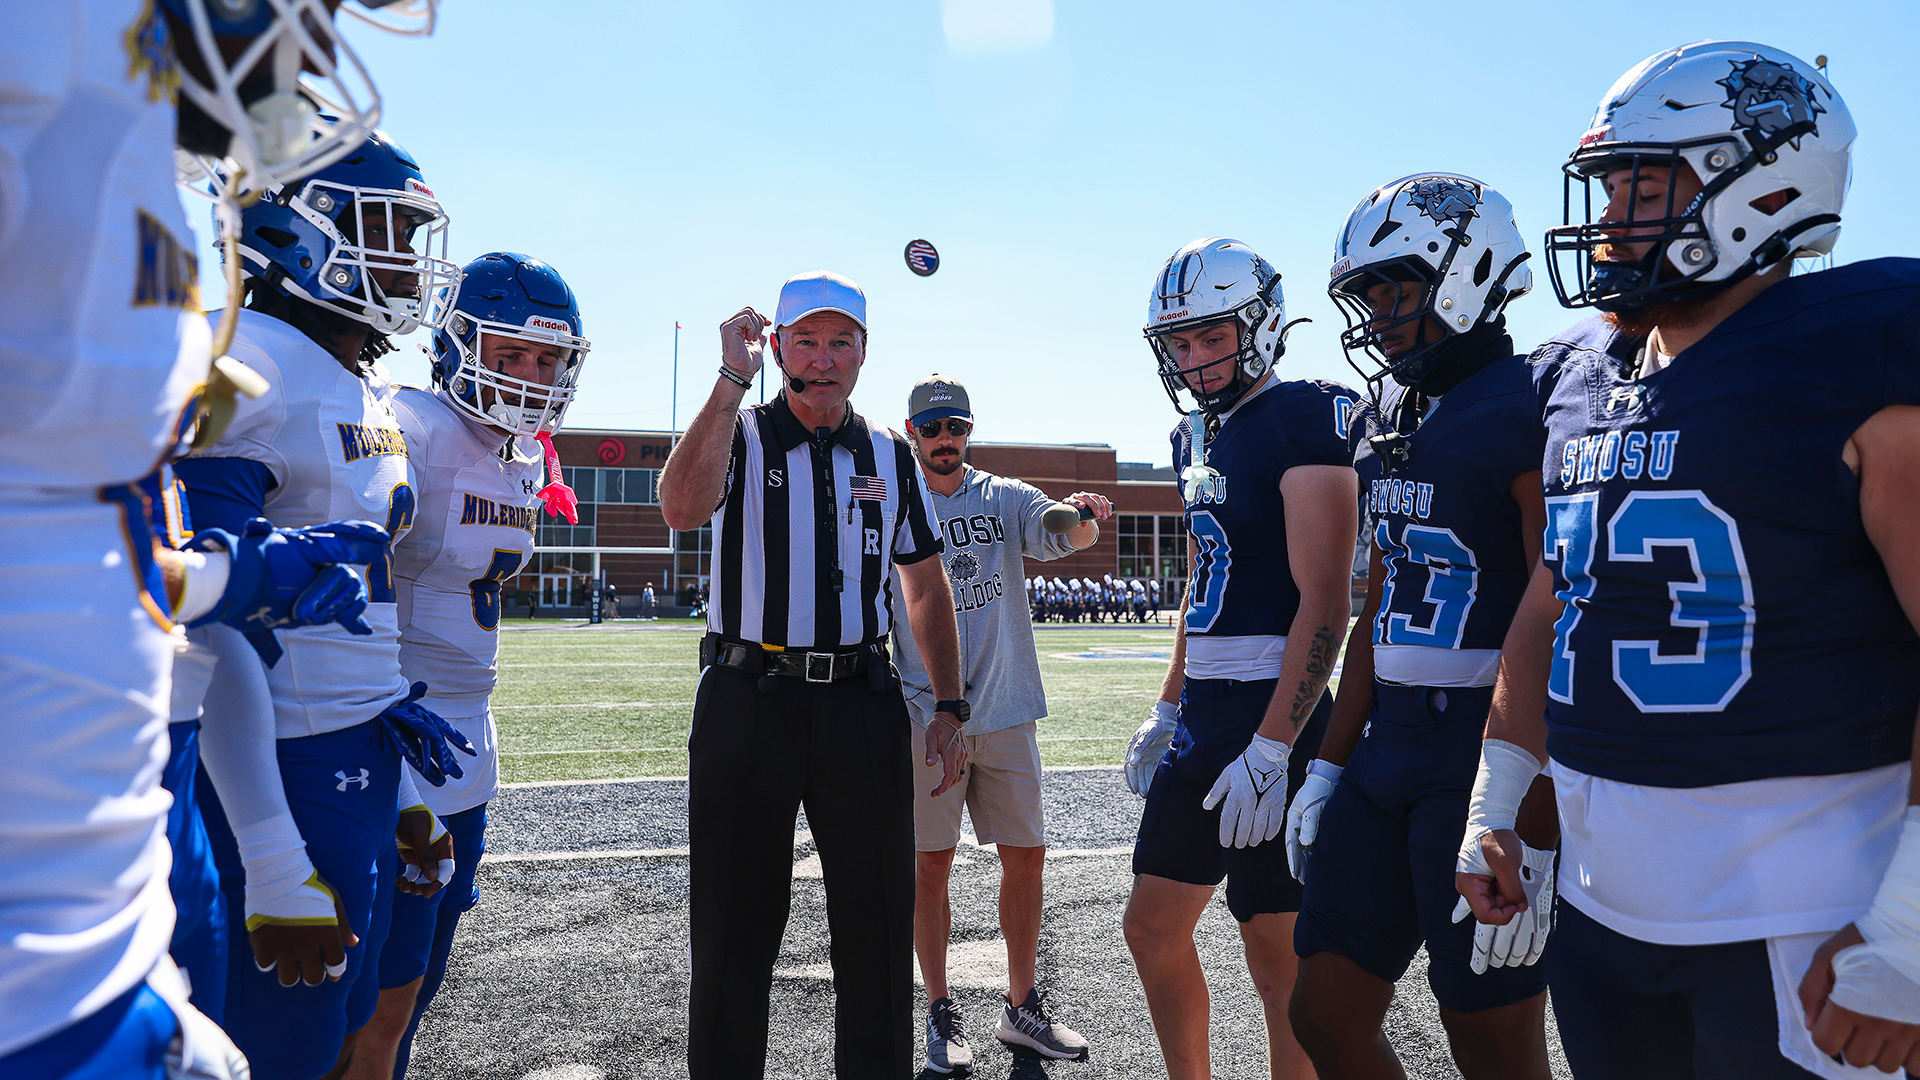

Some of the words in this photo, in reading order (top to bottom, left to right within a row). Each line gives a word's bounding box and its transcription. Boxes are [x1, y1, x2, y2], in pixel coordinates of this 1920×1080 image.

[1331, 260, 1351, 278] ddell
[533, 318, 568, 332] Riddell
[768, 469, 783, 488] S
[1561, 430, 1680, 490] SWOSU
[1371, 478, 1434, 519] SWOSU
[864, 528, 880, 555] R
[1184, 510, 1233, 633] 0
[1372, 518, 1481, 650] 13
[1544, 490, 1756, 713] 73
